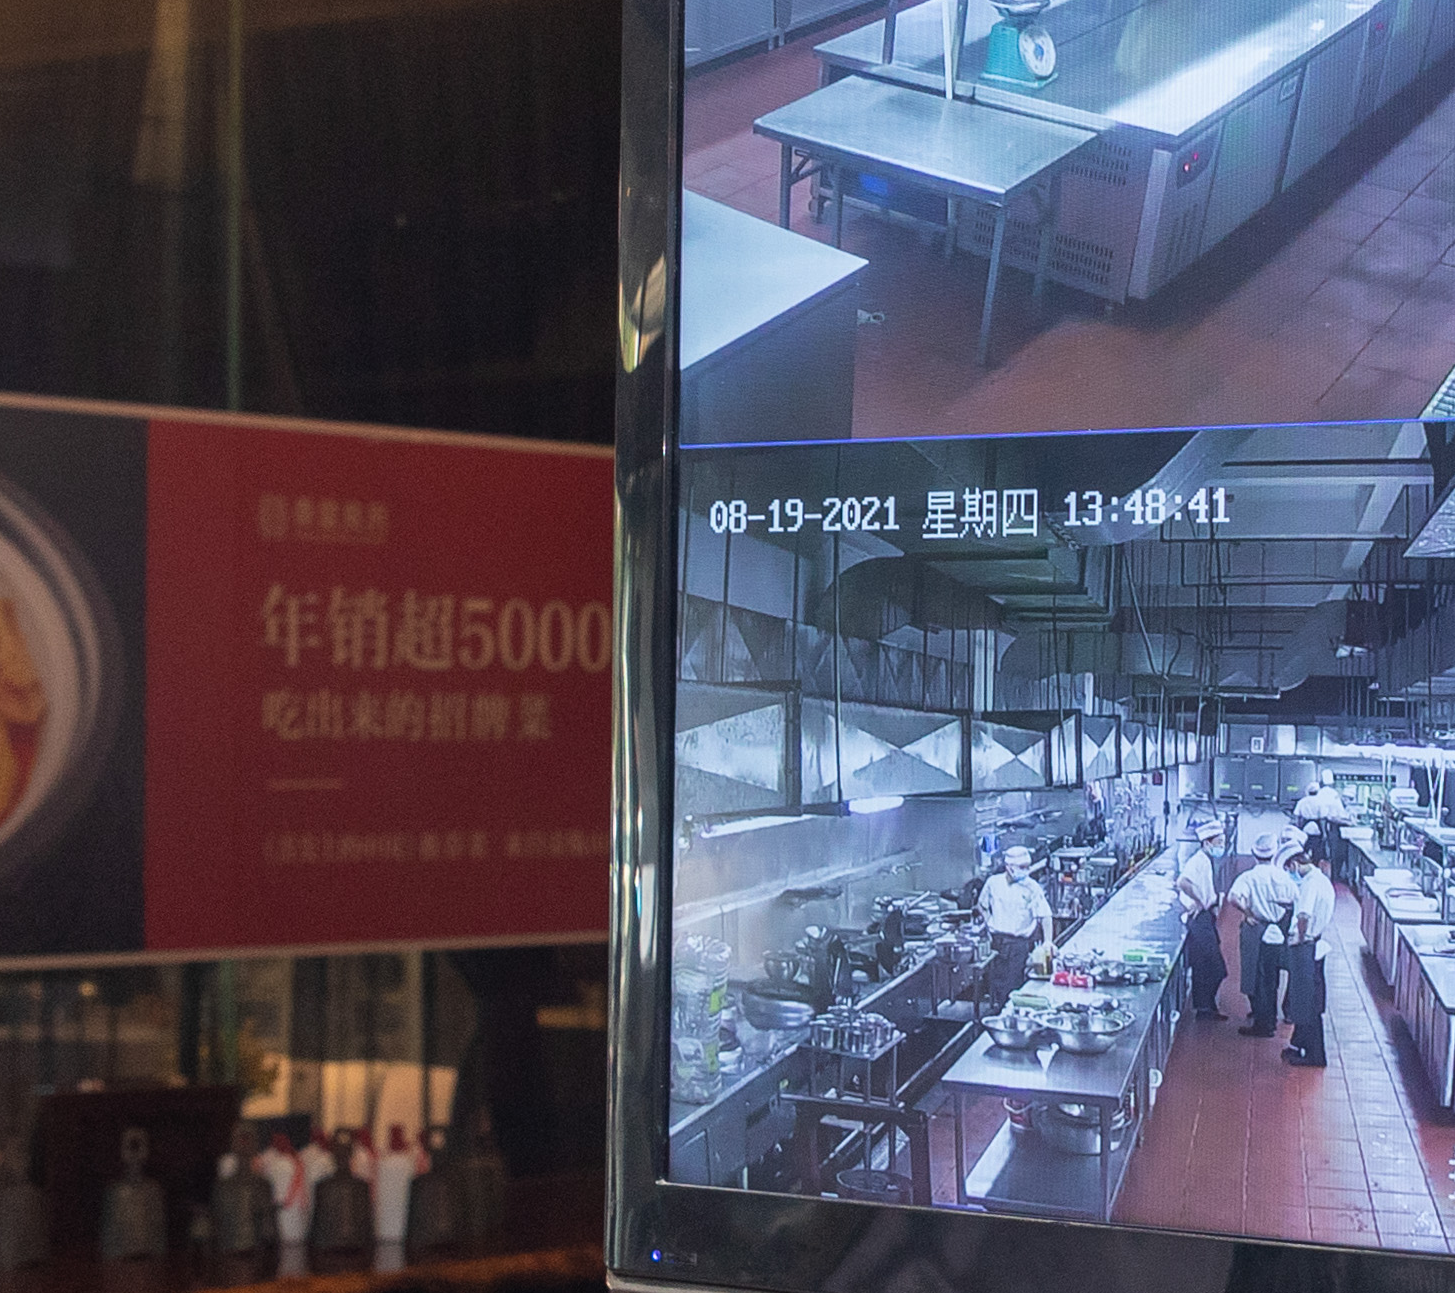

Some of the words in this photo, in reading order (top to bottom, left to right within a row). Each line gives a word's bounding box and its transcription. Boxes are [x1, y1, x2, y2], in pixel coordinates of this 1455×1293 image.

[709, 495, 900, 534] 08-19-2021
[921, 487, 1039, 540] 星期四
[1063, 484, 1230, 529] 13:48:41
